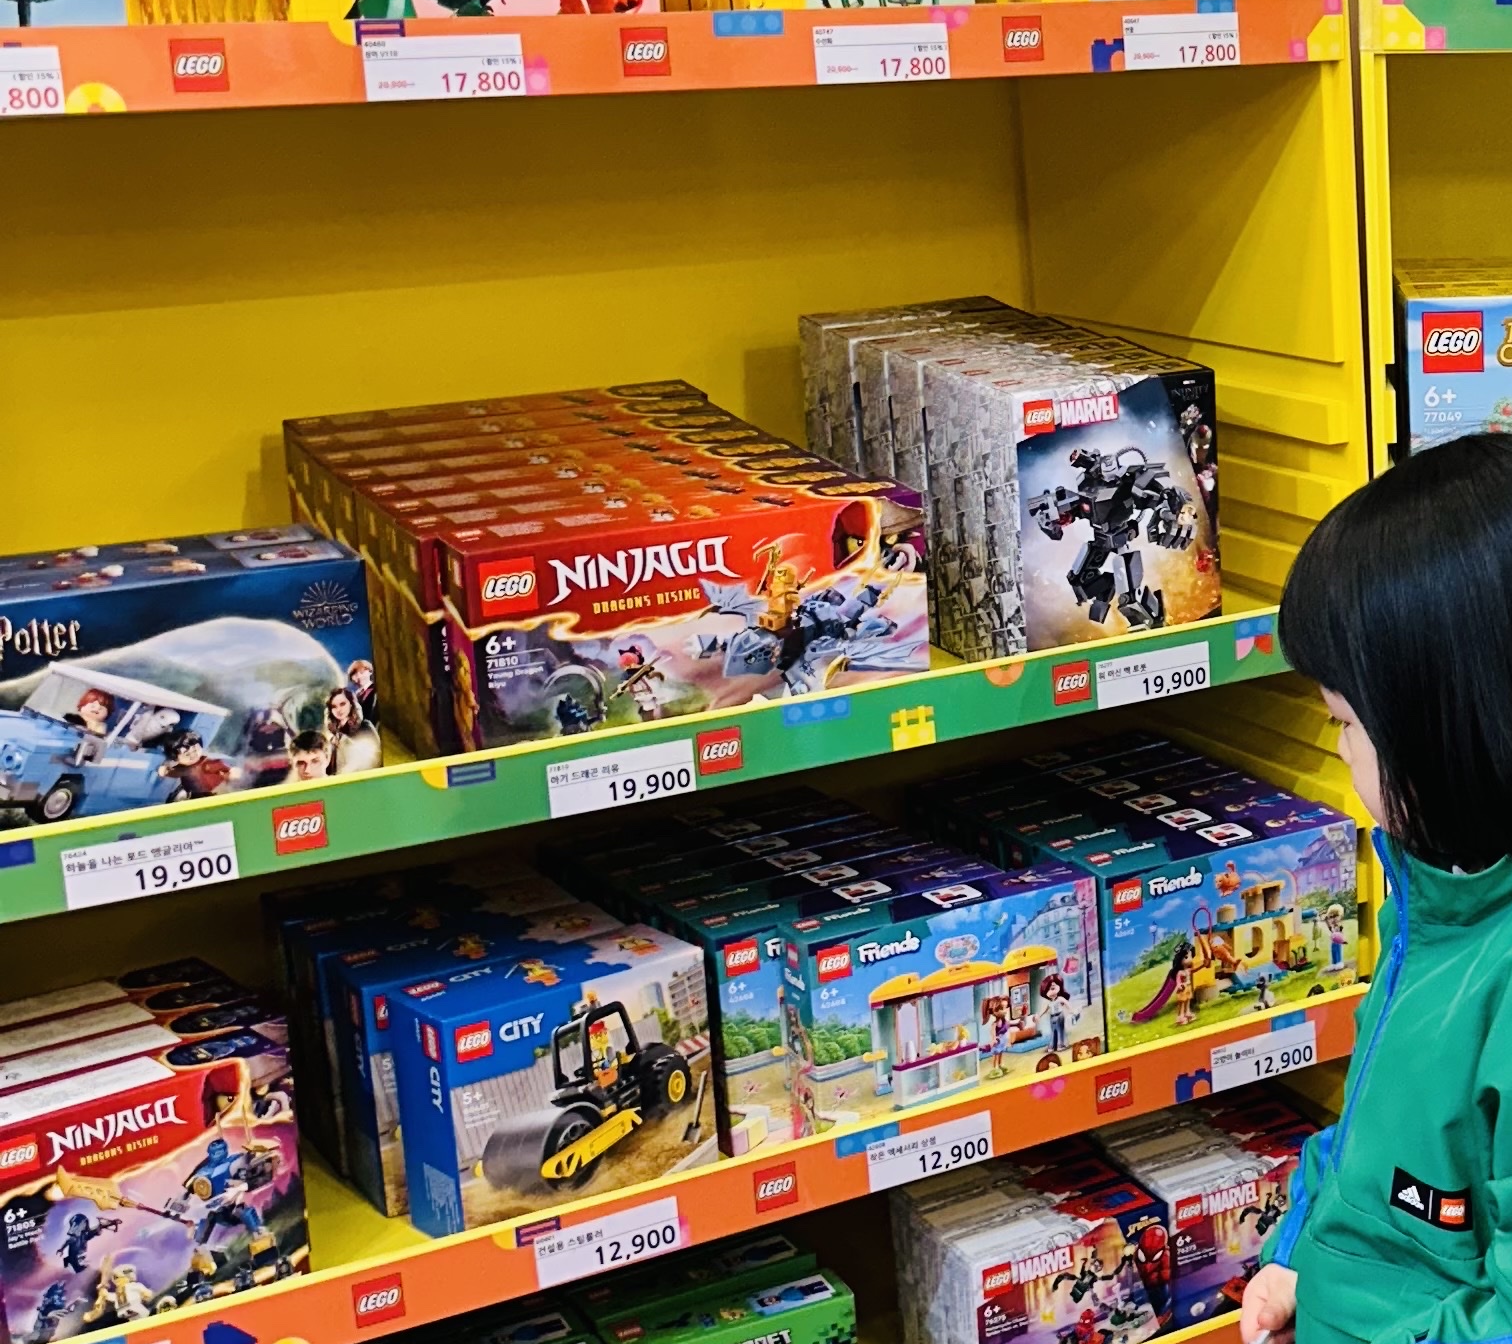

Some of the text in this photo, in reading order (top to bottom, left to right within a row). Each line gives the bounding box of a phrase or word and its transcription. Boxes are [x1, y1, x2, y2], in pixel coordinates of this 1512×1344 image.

[1005, 29, 1040, 48] LEGO
[625, 42, 665, 61] LEGO
[1180, 44, 1236, 64] 17,800
[175, 54, 224, 76] LEGO
[880, 57, 945, 78] 17,800
[442, 72, 521, 94] 17,800
[1425, 386, 1457, 407] 6+
[1027, 410, 1052, 424] LEGO
[1061, 396, 1117, 426] MARVEL
[1424, 411, 1462, 422] 77049
[548, 535, 742, 607] NINJAGO
[593, 588, 700, 614] DRAGONS RISING
[0, 616, 80, 661] Potter
[485, 635, 517, 655] 6+
[486, 656, 518, 669] 71810
[1143, 667, 1206, 695] 19,900
[551, 774, 568, 784] 아기
[572, 769, 599, 779] 드래곤
[609, 769, 690, 801] 19,900
[66, 856, 122, 873] 하늘을 나는
[135, 854, 232, 890] 19,900
[1148, 866, 1203, 897] Friends
[1116, 887, 1141, 904] LEGO
[1114, 918, 1131, 930] 5+
[857, 931, 921, 963] Friends
[727, 948, 757, 967] LEGO
[819, 955, 850, 973] LEGO
[449, 967, 492, 982] CITY
[728, 982, 747, 994] 6+
[820, 988, 838, 999] 6+
[500, 1013, 544, 1042] CITY
[459, 1030, 490, 1051] LEGO
[1255, 1045, 1313, 1076] 12,900
[463, 1092, 482, 1104] 5+
[46, 1095, 188, 1165] NINJAGO
[1, 1146, 36, 1167] LEGO
[920, 1137, 988, 1172] 12,900
[1208, 1181, 1260, 1217] MARVEL
[4, 1208, 27, 1223] 6+
[1177, 1203, 1201, 1221] LEGO
[1440, 1205, 1464, 1217] LEGO
[6, 1220, 35, 1233] 71805
[538, 1240, 564, 1256] 건설용
[596, 1225, 676, 1265] 12,900
[1176, 1236, 1192, 1248] 6+
[1018, 1246, 1074, 1284] MARVEL
[985, 1272, 1010, 1288] LEGO
[984, 1305, 1000, 1318] 6+
